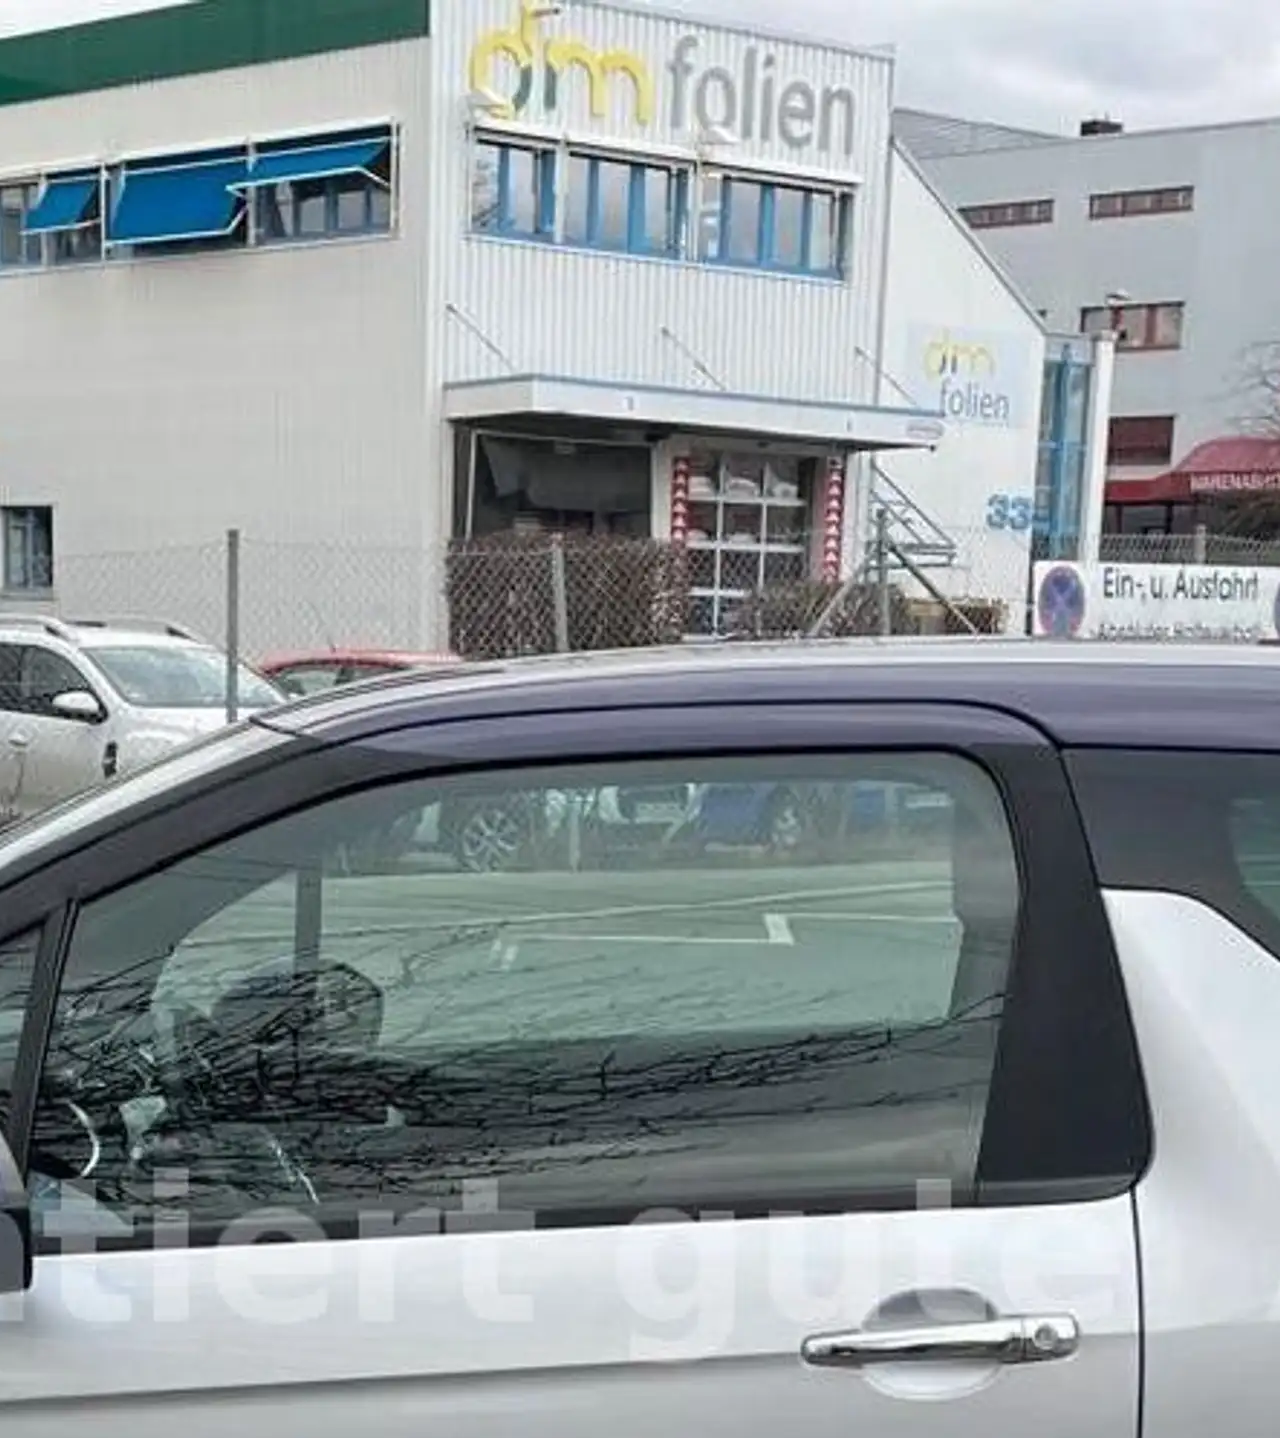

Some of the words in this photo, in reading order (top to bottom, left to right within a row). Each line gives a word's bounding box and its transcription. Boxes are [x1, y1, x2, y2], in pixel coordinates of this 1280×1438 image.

[469, 0, 650, 125] dm
[668, 34, 855, 156] folien
[924, 330, 995, 381] dm
[940, 377, 1010, 421] folien
[1173, 571, 1257, 601] Ausfahrt
